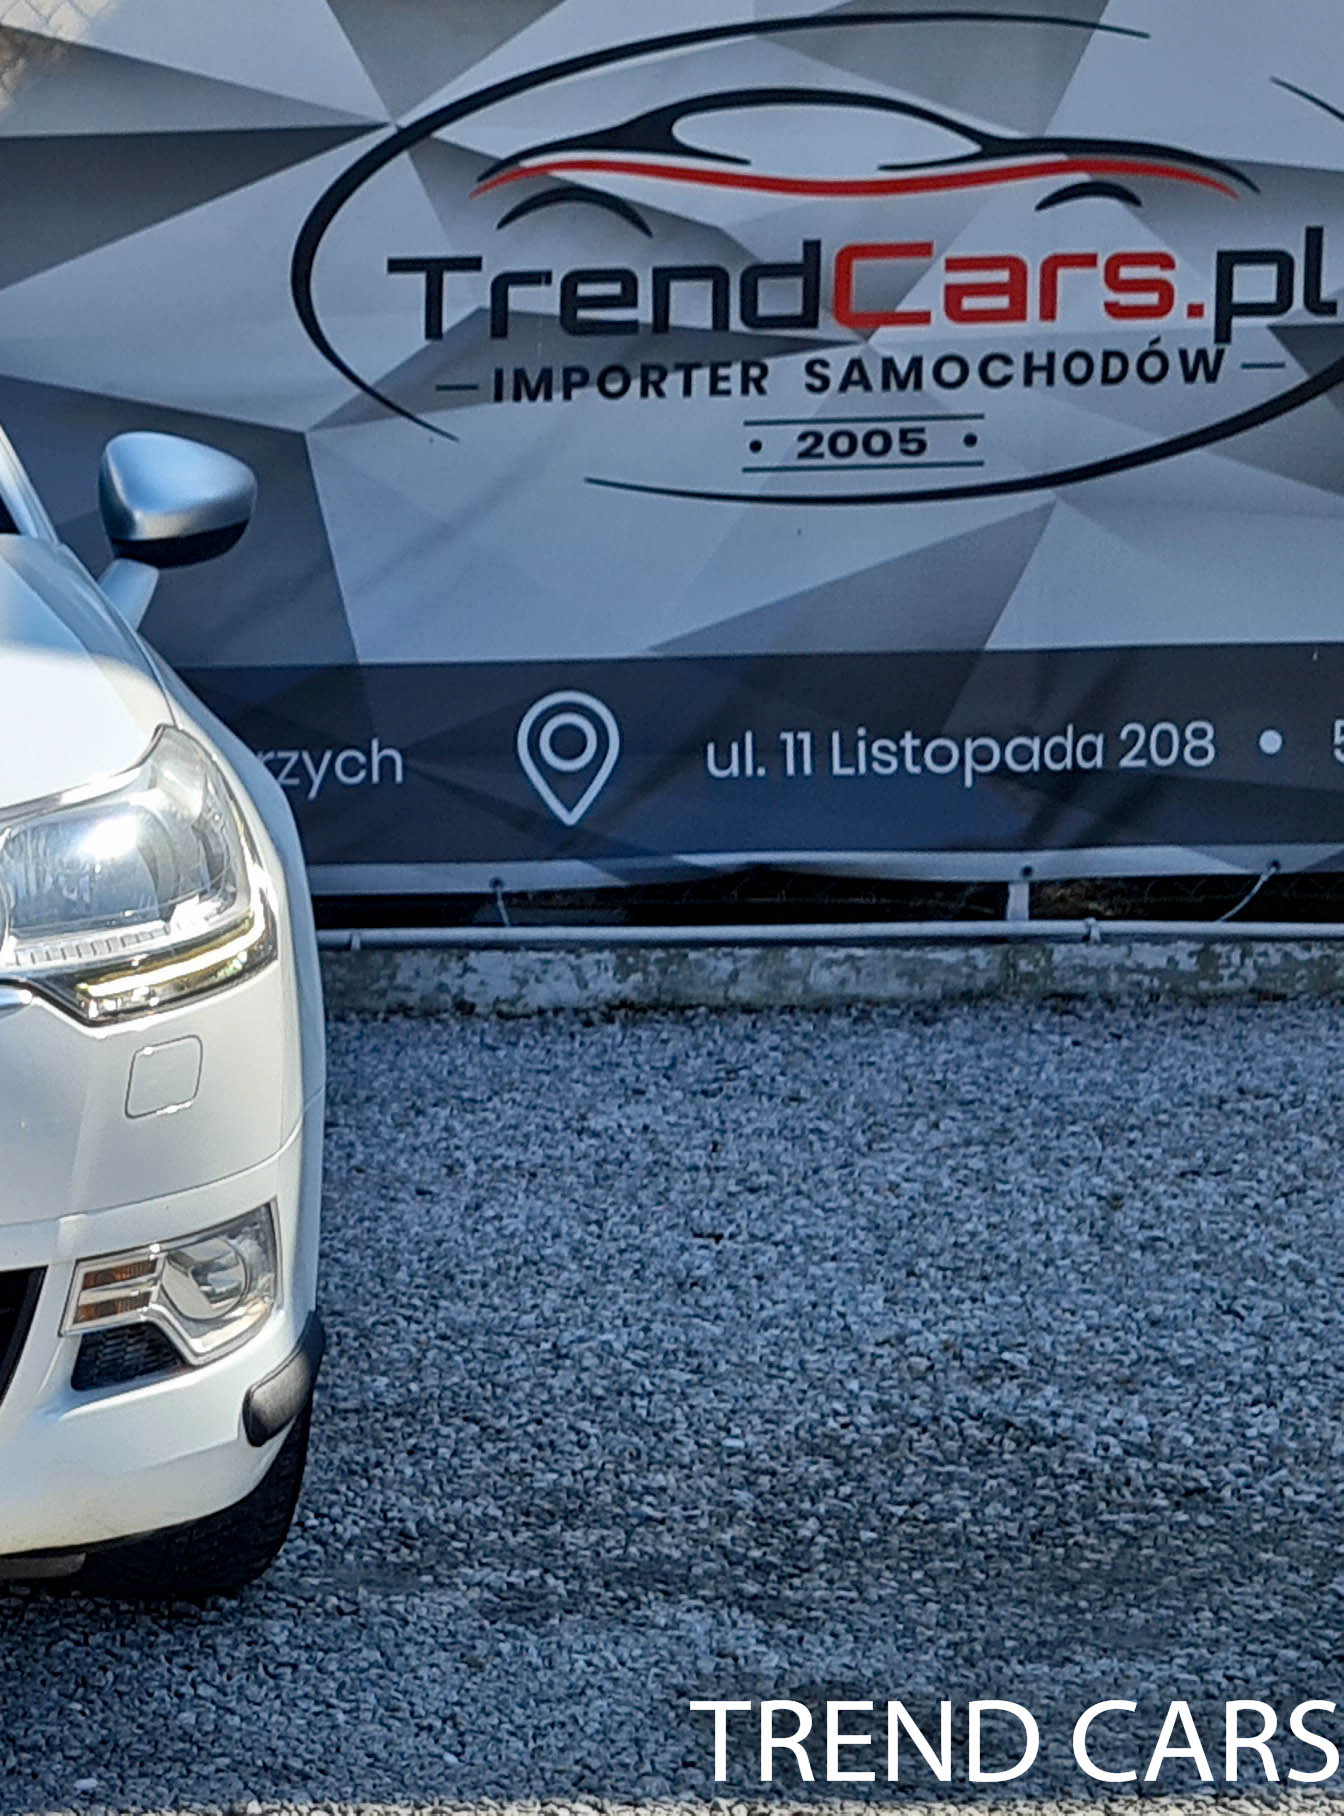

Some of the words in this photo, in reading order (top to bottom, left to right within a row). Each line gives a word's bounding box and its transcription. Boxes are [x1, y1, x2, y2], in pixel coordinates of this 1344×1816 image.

[388, 227, 1338, 344] TrendCars.pl
[493, 361, 770, 404] IMPORTER
[805, 338, 1226, 396] SAMOCHODÓW
[796, 426, 929, 461] 2005
[706, 730, 765, 779] ul.
[779, 730, 814, 776] 11
[831, 722, 1106, 788] Listopada
[1118, 720, 1216, 769] 208
